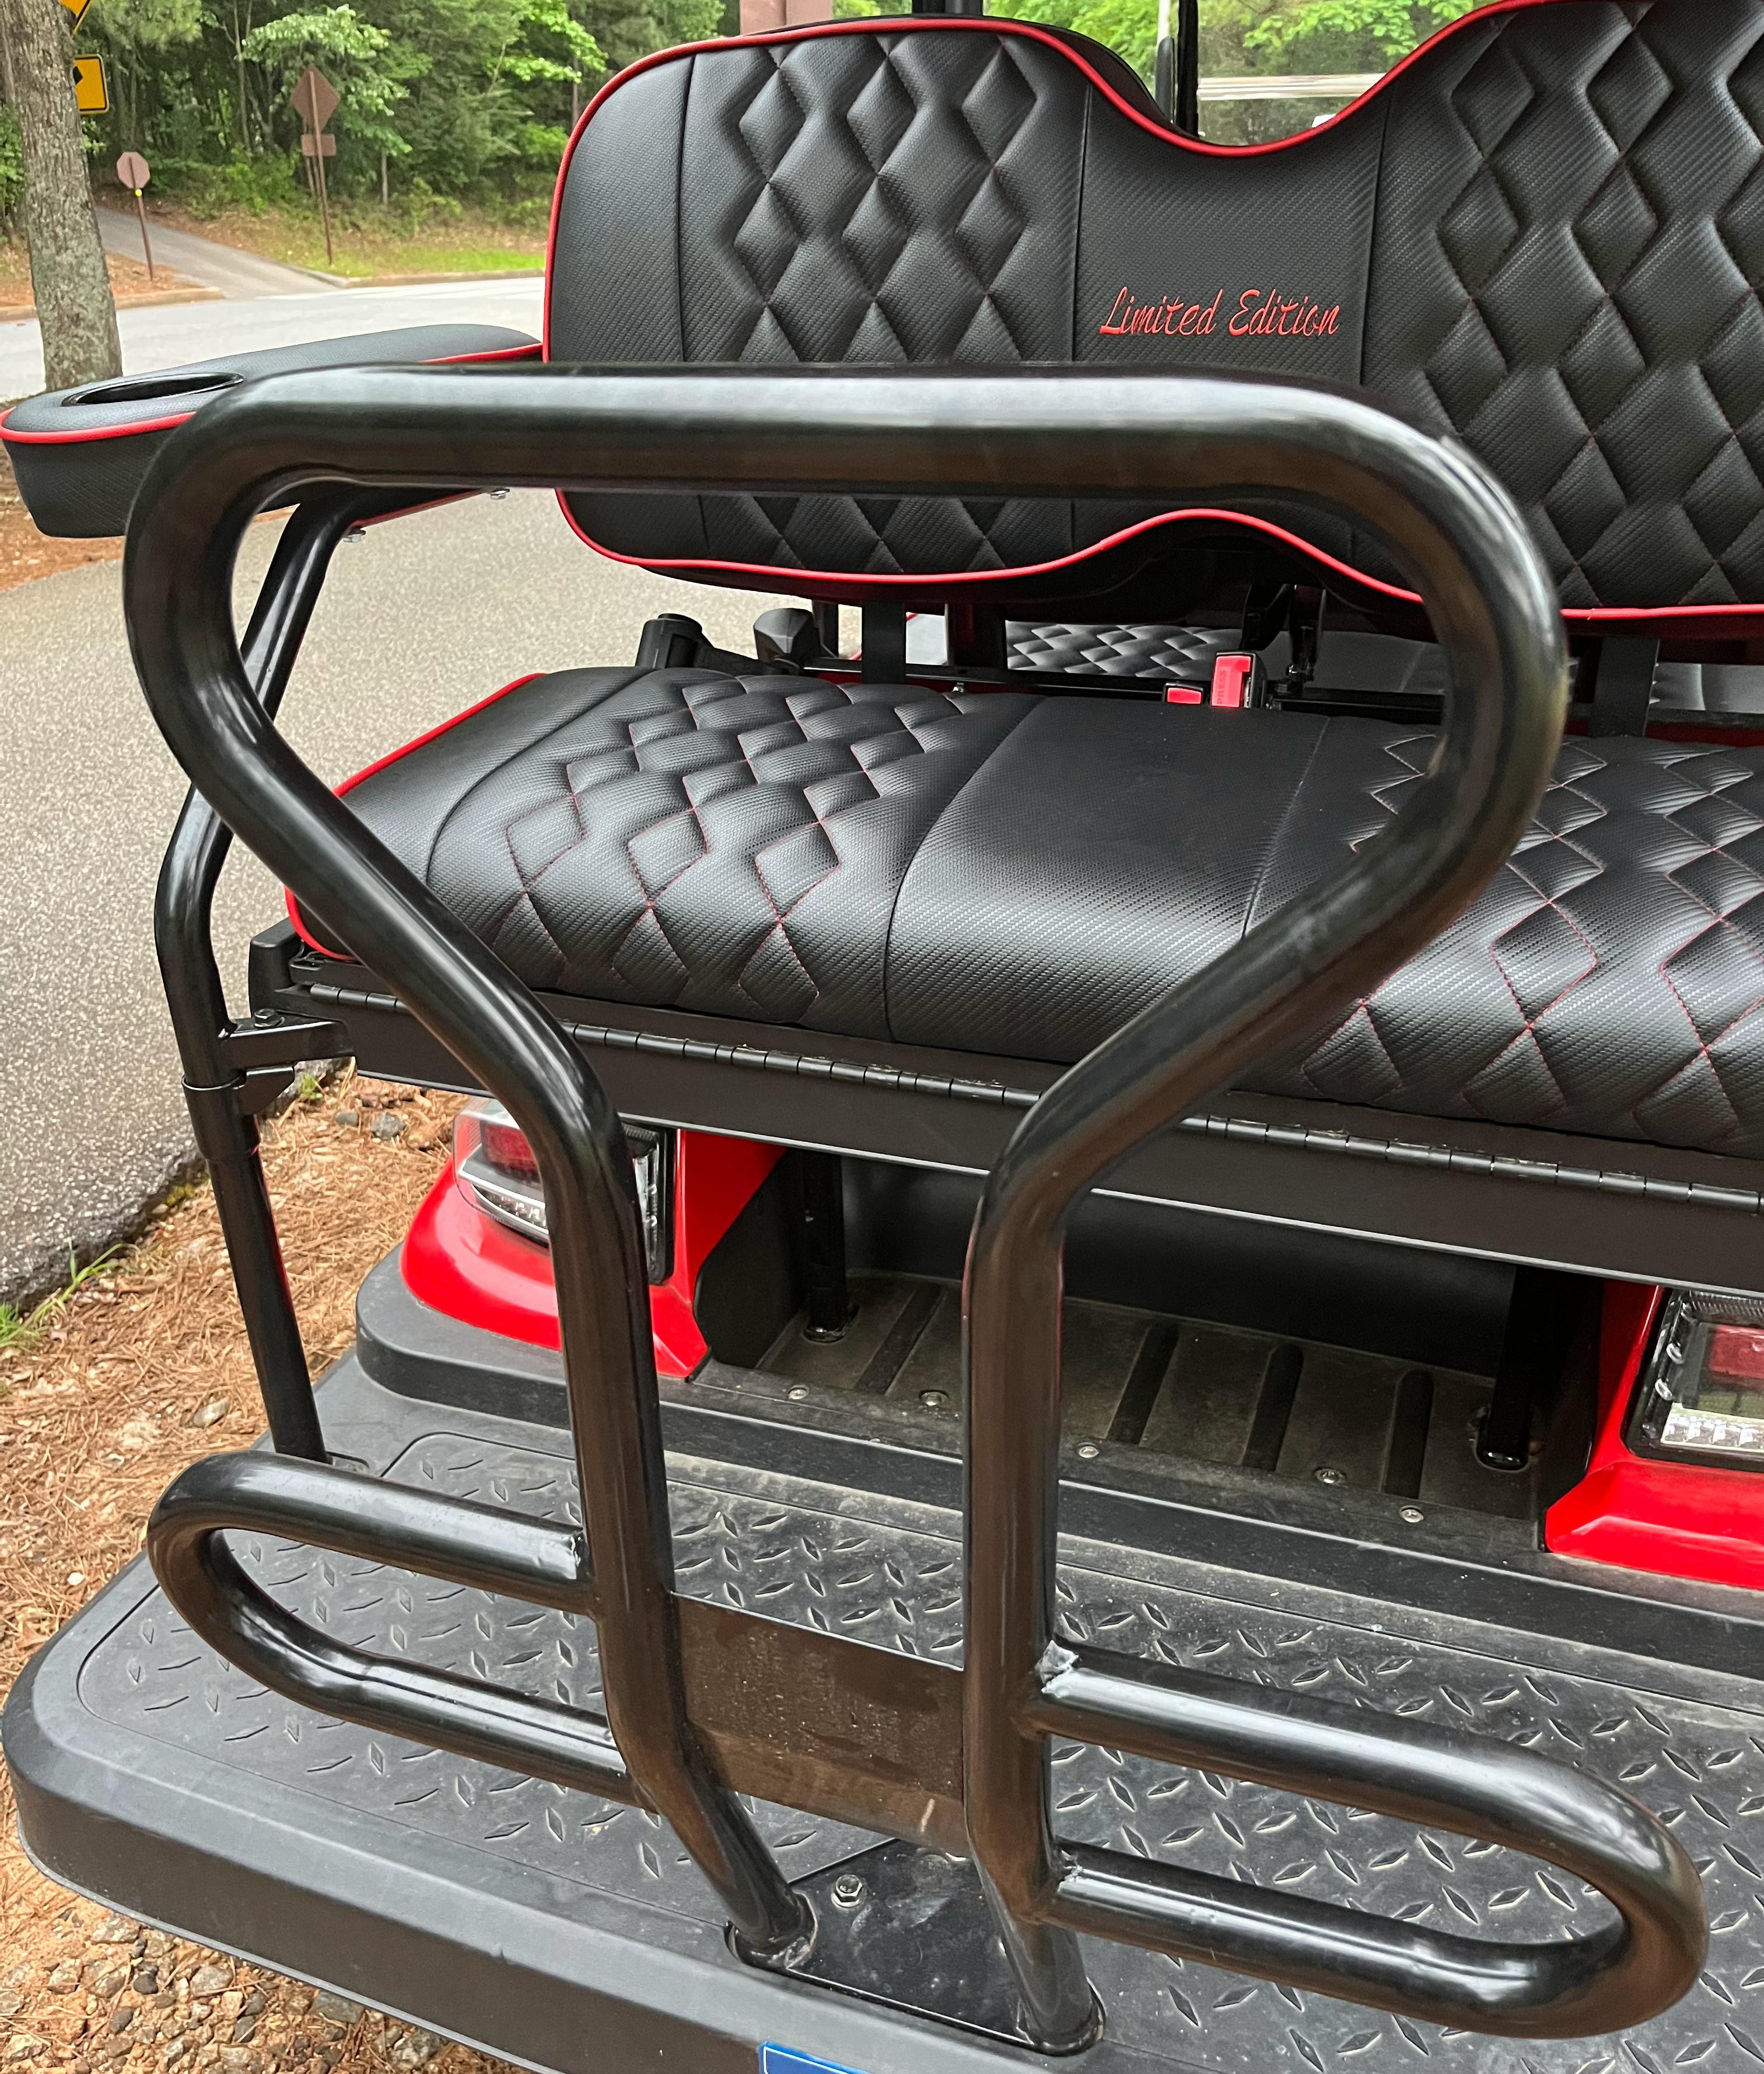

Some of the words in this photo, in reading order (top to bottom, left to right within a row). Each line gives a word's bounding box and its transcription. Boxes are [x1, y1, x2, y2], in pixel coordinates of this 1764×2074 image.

[1099, 286, 1223, 336] Limited
[1228, 289, 1340, 337] Edition
[1217, 671, 1226, 704] PRESS
